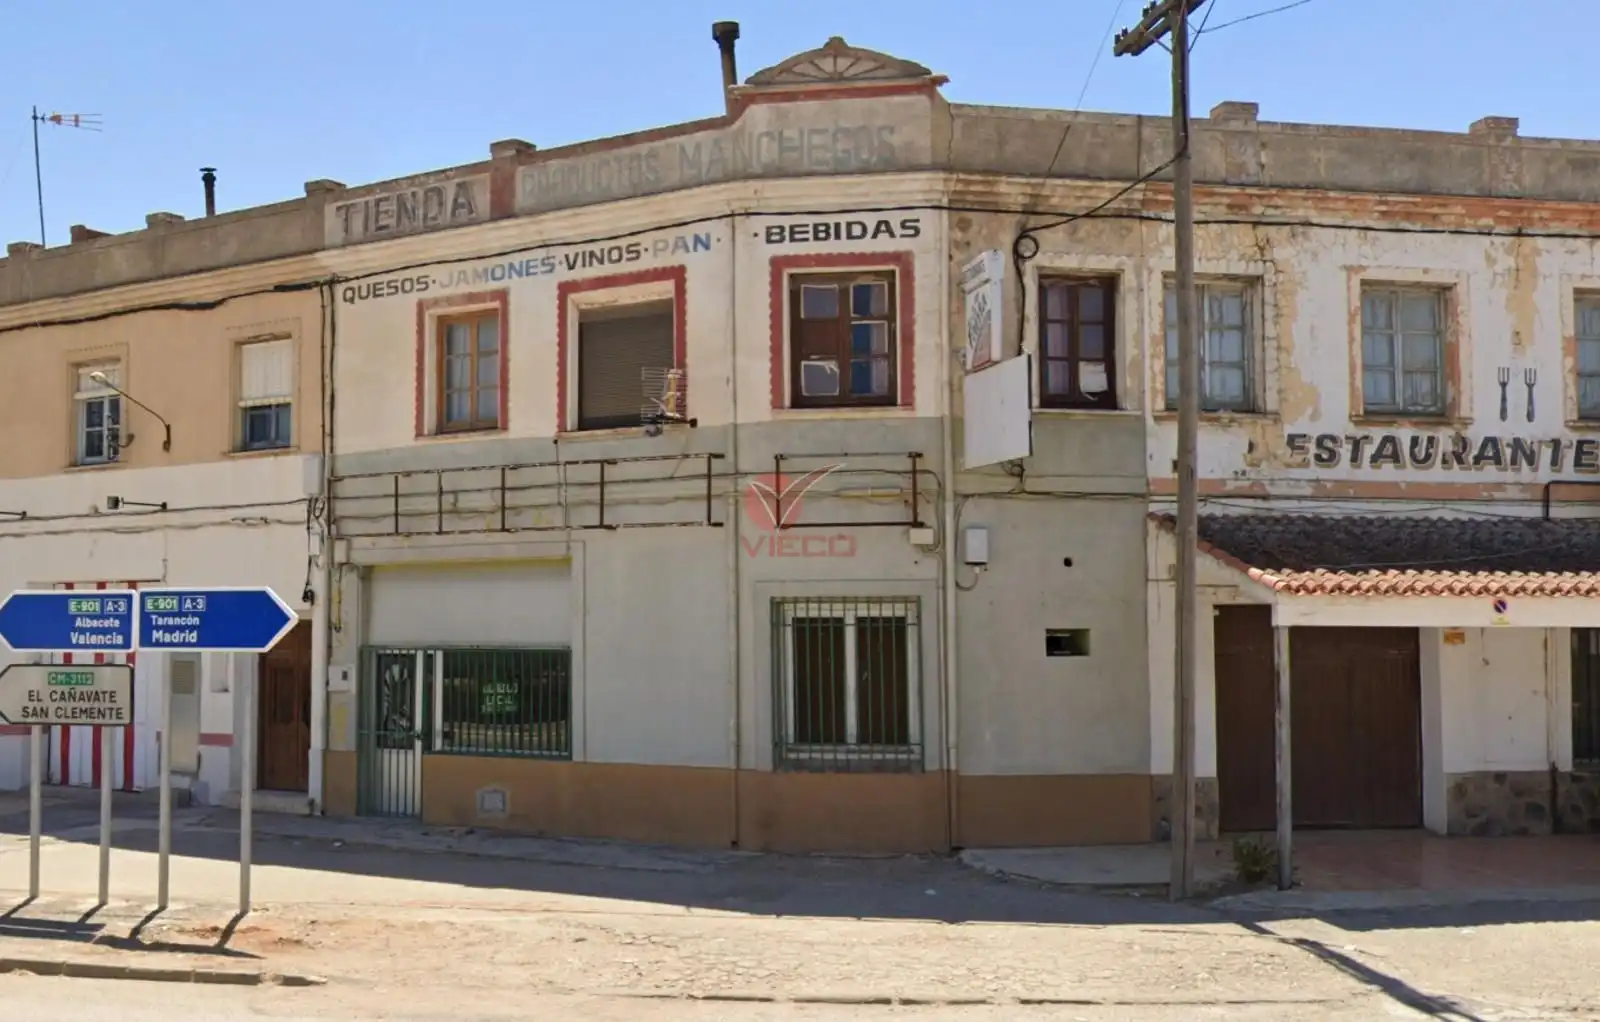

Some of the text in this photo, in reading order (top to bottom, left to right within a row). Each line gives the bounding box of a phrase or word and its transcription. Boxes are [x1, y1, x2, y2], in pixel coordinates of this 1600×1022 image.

[678, 124, 896, 180] MANCHEGOS
[335, 180, 479, 238] TIENDA
[765, 218, 921, 244] BEBIDAS
[343, 232, 712, 304] QUESOS JAMONES VINOS PAN
[1245, 432, 1600, 473] ESTAURANTE
[70, 601, 125, 612] E-901 A-3
[147, 598, 204, 609] E-901 A-3
[75, 617, 120, 628] Albacete
[151, 615, 200, 626] Tarancón
[70, 632, 123, 645] Valencia
[152, 629, 198, 643] Madrid
[28, 687, 117, 704] EL CAÑAVATE
[21, 706, 124, 720] SAN CLEMENTE
